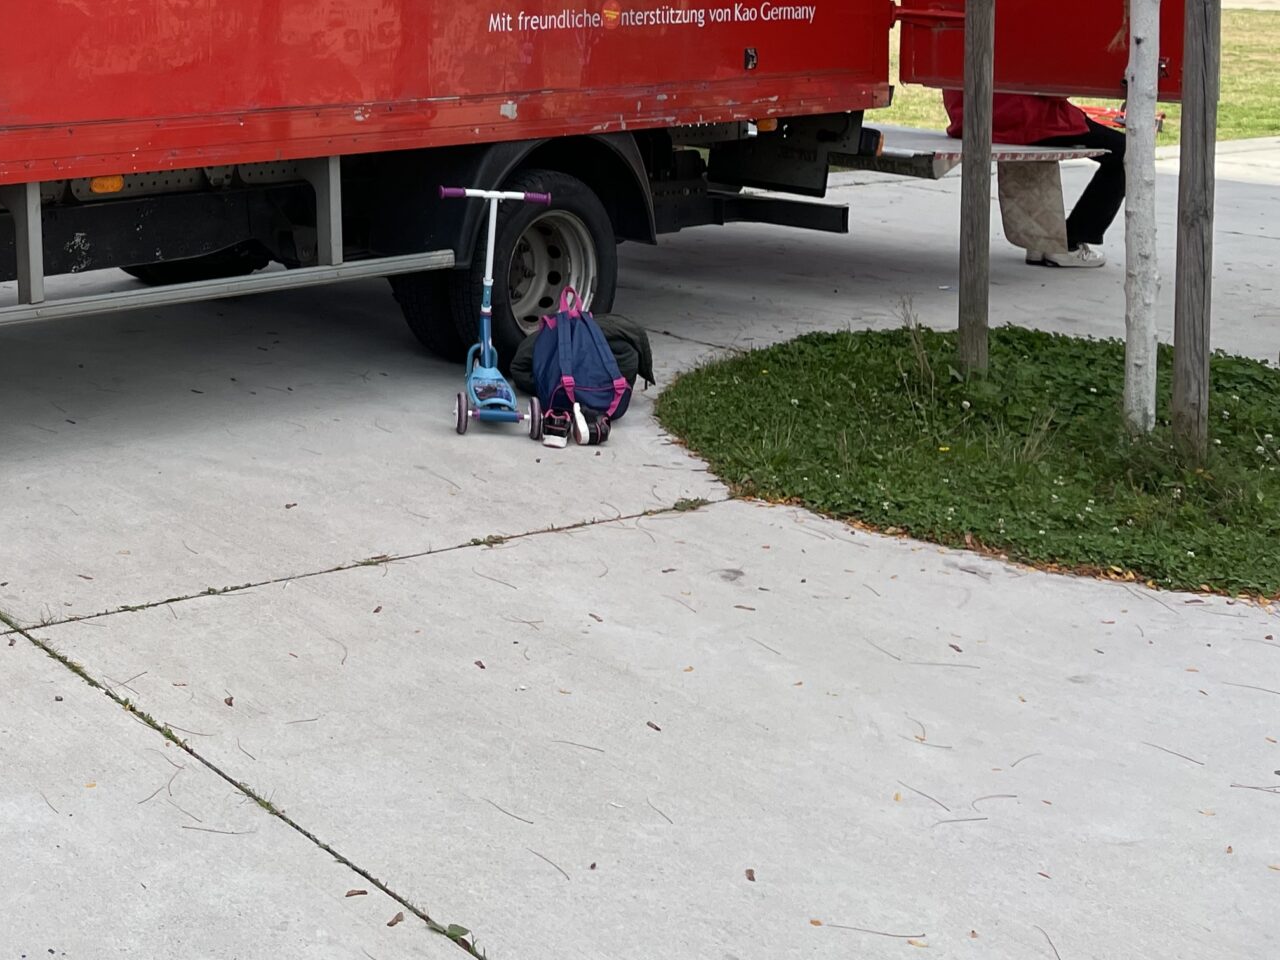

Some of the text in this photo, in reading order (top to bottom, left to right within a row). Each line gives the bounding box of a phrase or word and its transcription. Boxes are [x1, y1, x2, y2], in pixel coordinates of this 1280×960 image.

[488, 13, 513, 32] Mit
[621, 5, 705, 27] nterstützung
[709, 8, 731, 22] von
[734, 3, 757, 21] Kao
[760, 2, 816, 24] Germany
